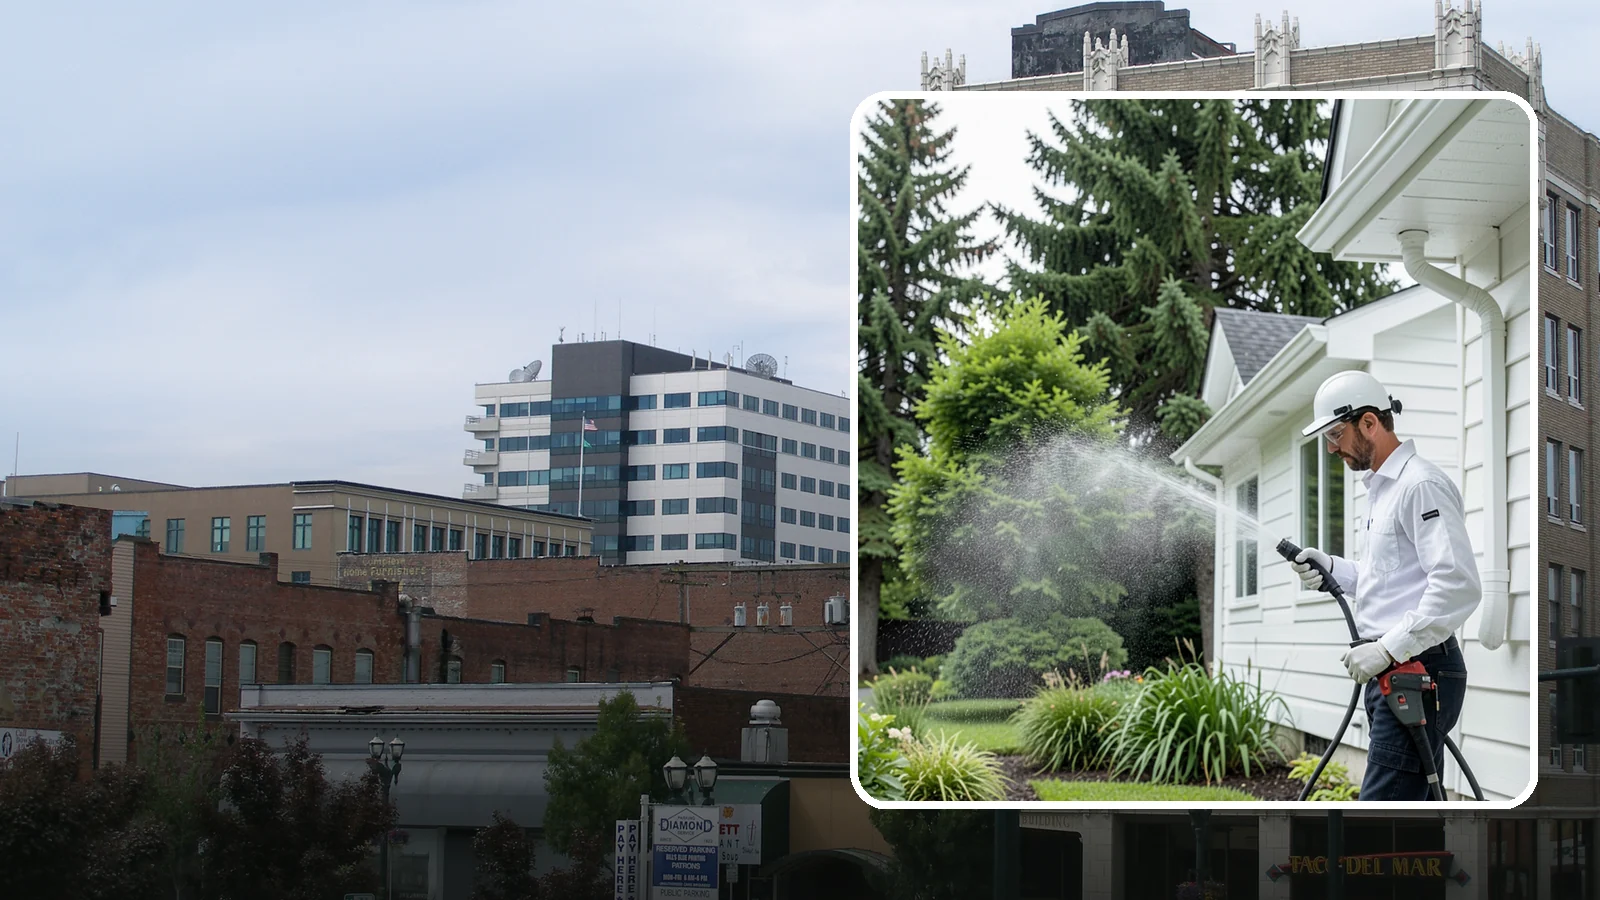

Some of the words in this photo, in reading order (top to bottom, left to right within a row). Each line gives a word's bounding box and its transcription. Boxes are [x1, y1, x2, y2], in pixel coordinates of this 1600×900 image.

[371, 566, 427, 576] Furnishers
[1021, 816, 1070, 828] BUILDING
[720, 824, 740, 835] ETT
[720, 839, 739, 848] ANT
[722, 852, 738, 862] Soup
[1289, 856, 1328, 873] TAC
[1346, 856, 1384, 875] DEL
[1392, 857, 1442, 877] MAR
[628, 856, 636, 893] HERE
[660, 888, 682, 897] PUBLIC
[684, 889, 710, 898] PARKING
